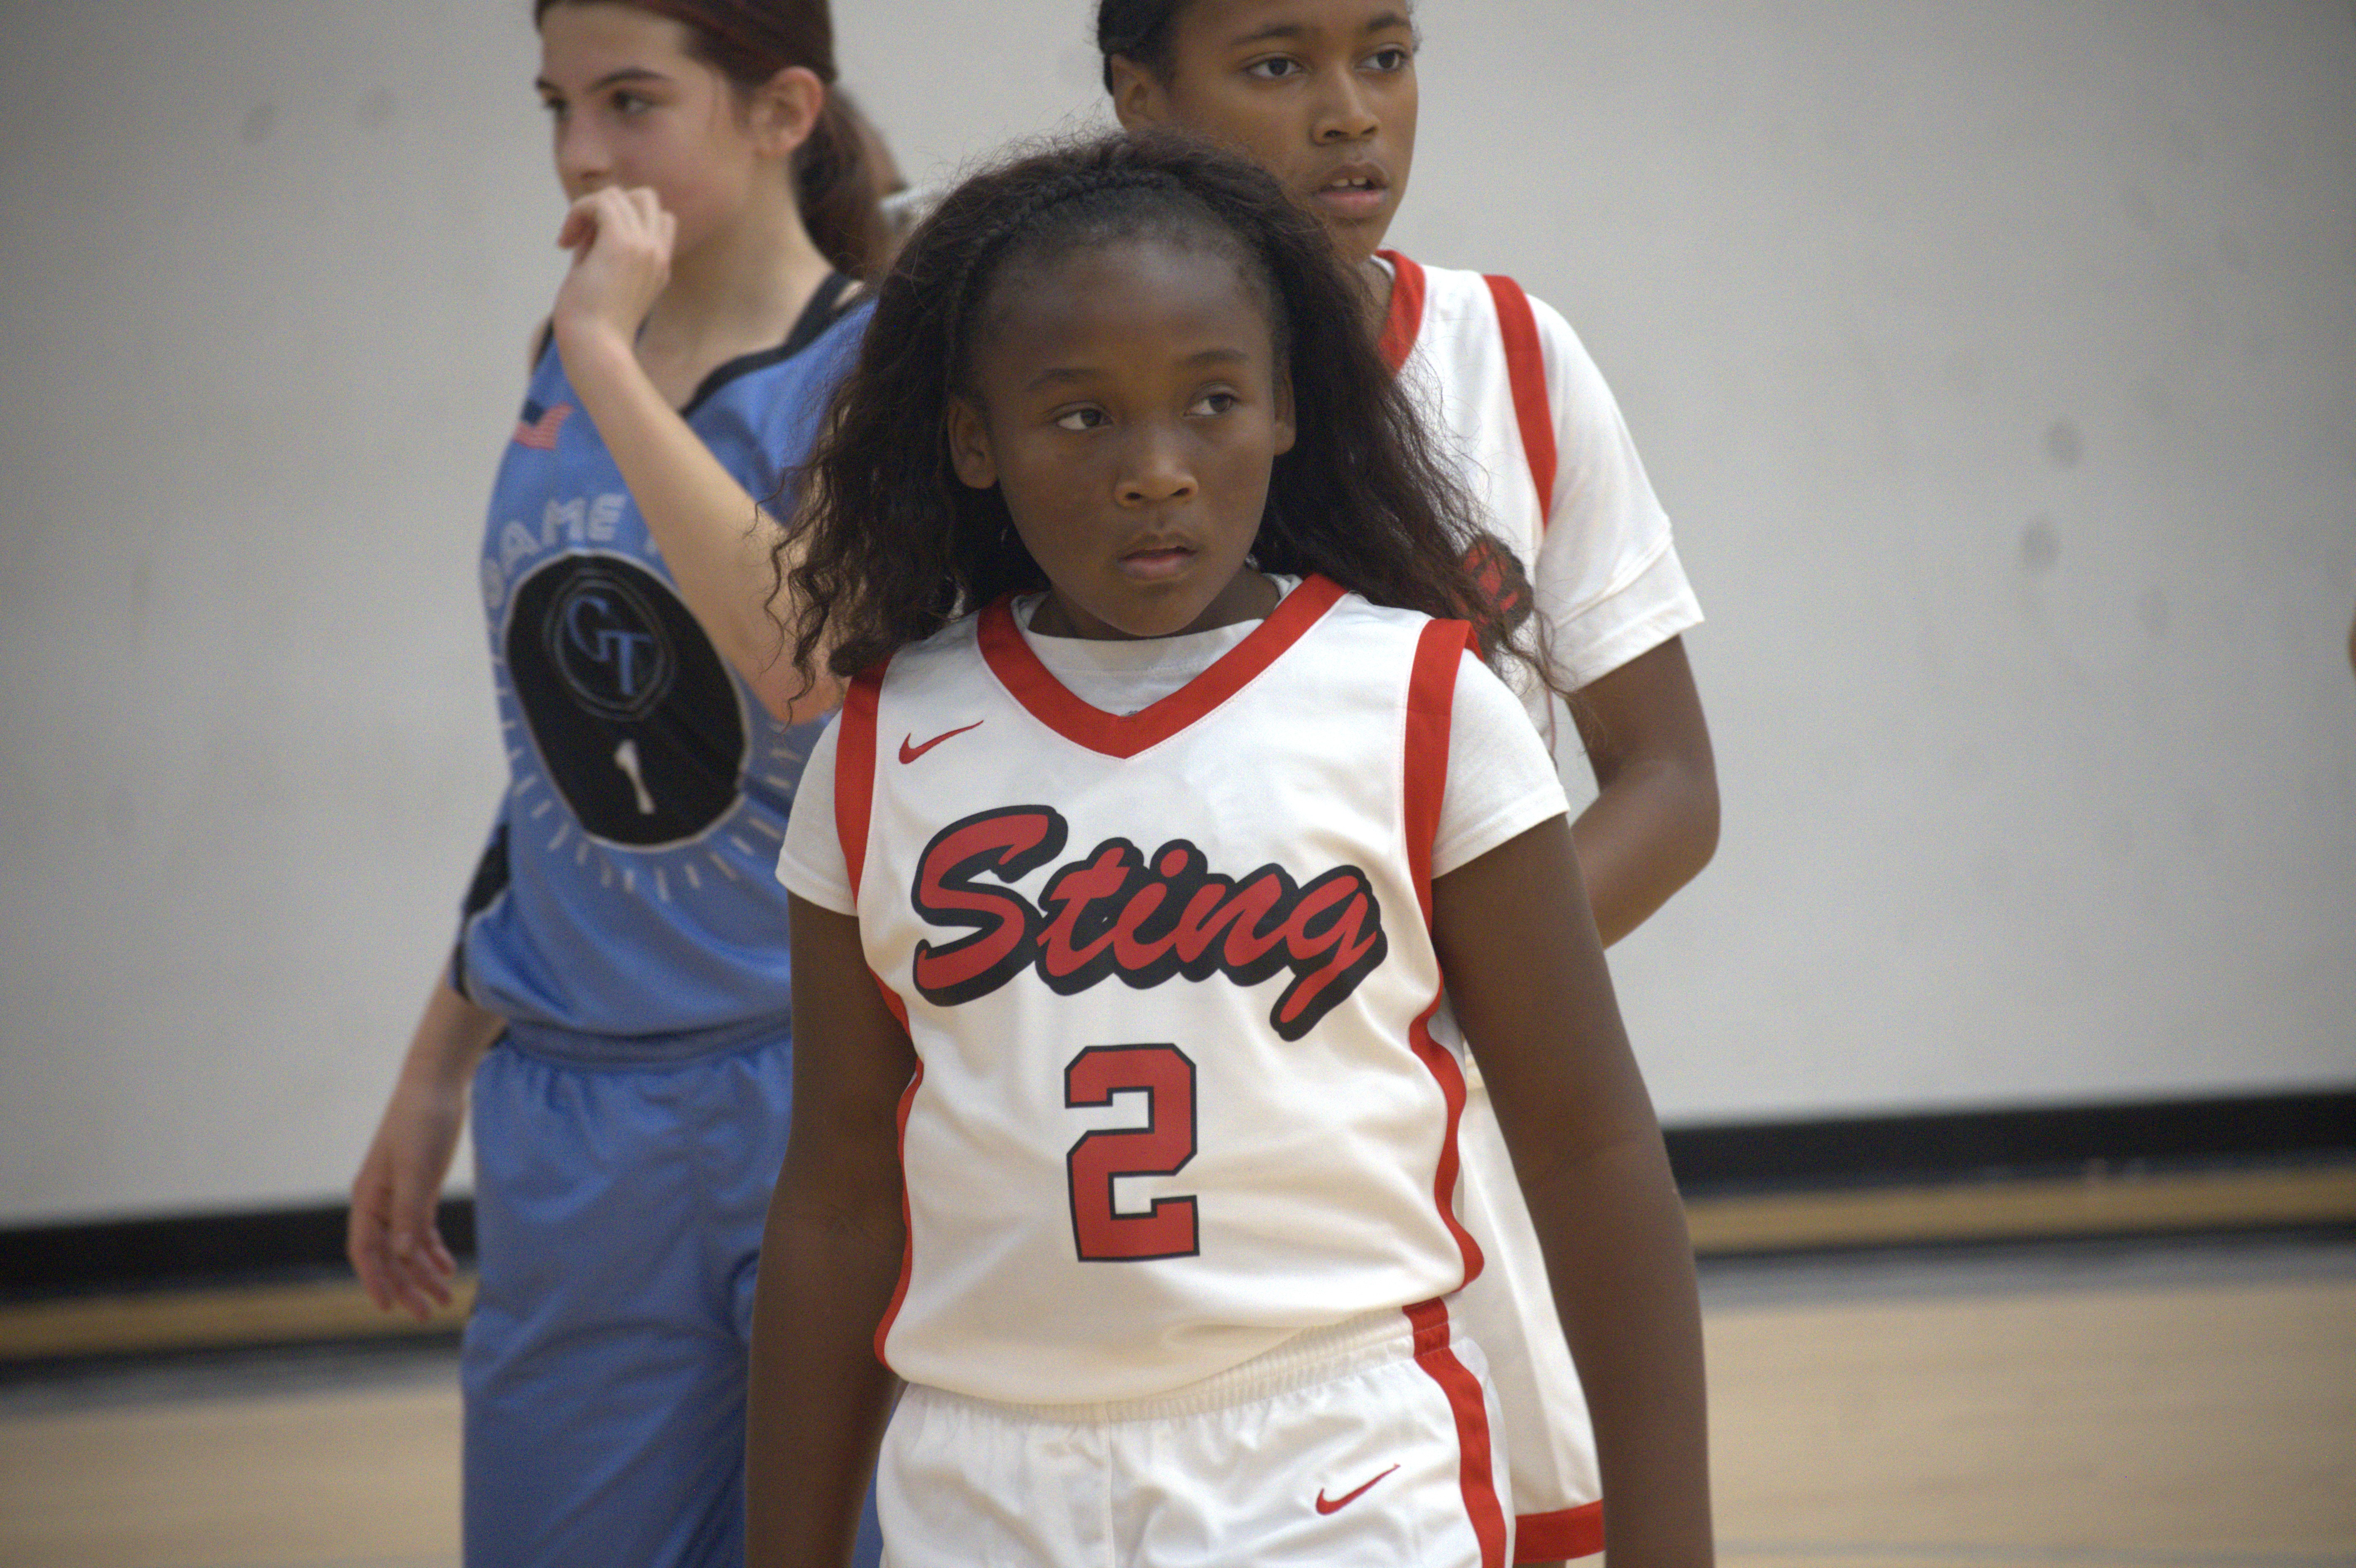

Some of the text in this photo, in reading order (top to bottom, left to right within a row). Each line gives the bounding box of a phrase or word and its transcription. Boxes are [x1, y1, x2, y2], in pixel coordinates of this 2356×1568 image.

[567, 594, 653, 695] GT
[614, 739, 654, 814] 1
[911, 805, 1388, 1041] Sting
[1064, 1043, 1200, 1262] 2
